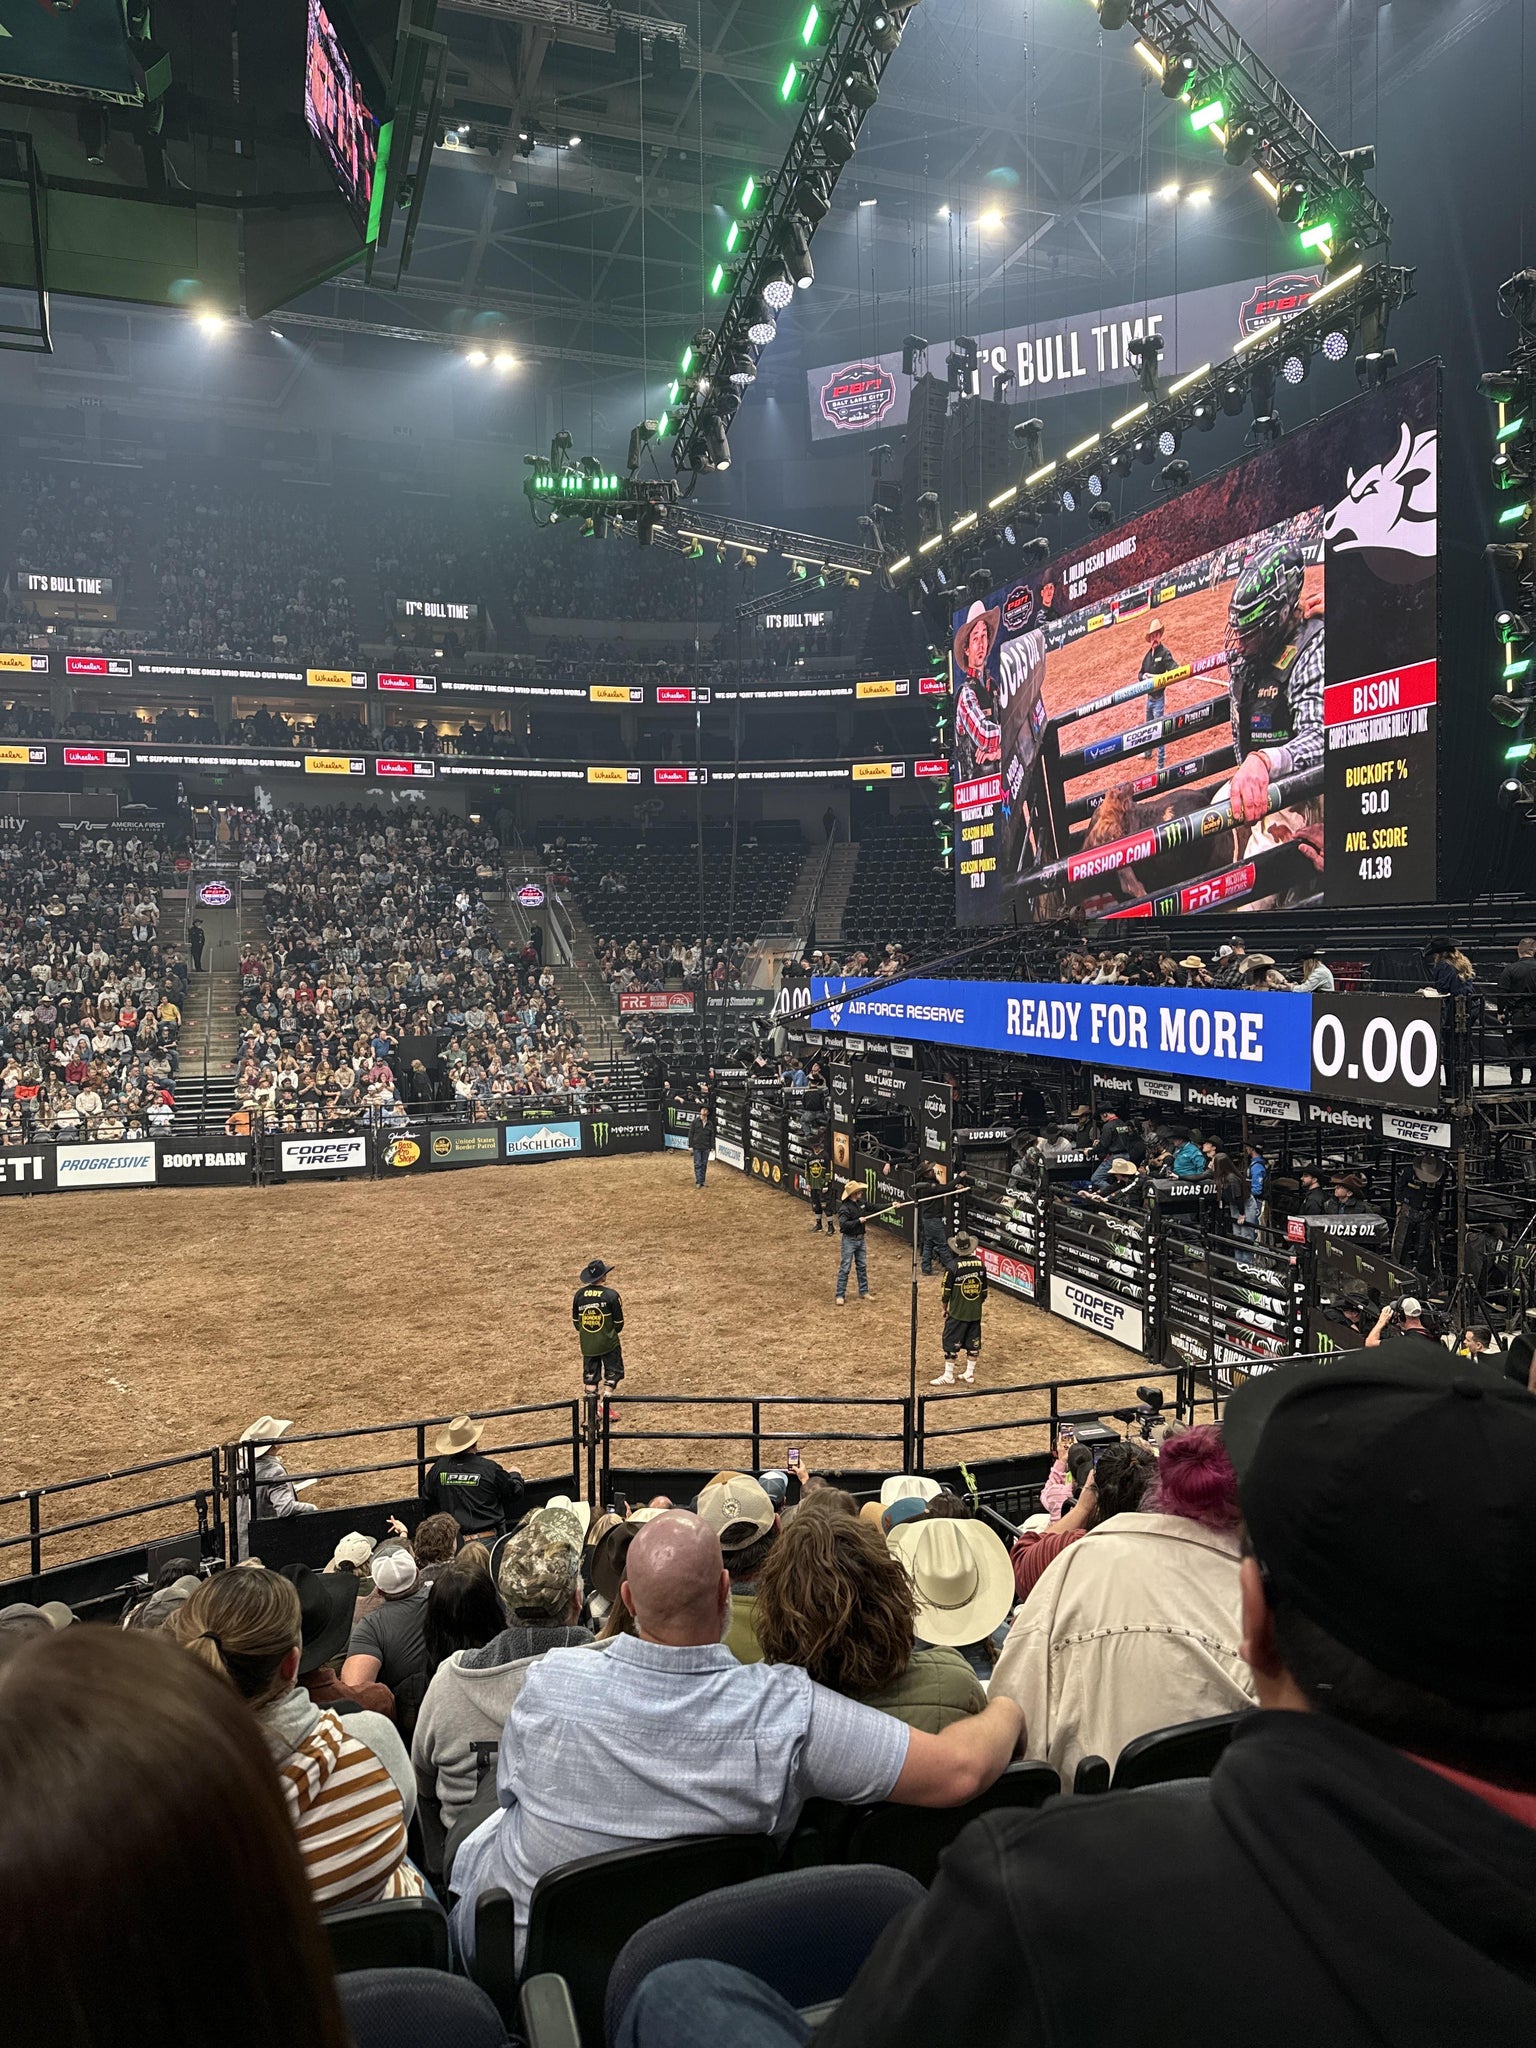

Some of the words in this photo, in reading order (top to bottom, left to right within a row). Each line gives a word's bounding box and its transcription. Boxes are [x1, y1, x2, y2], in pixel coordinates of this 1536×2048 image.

[1017, 331, 1086, 387] BULL
[832, 399, 848, 407] SALT
[850, 396, 867, 405] LAKE
[868, 393, 884, 401] CITY
[1069, 561, 1084, 583] JULIO
[1085, 551, 1105, 575] CESAR
[1106, 535, 1136, 565] MARQUES
[28, 575, 48, 591] IT'S
[50, 576, 75, 592] BULL
[76, 578, 102, 594] TIME
[1069, 577, 1088, 600] 86.05
[424, 602, 446, 618] BULL
[447, 604, 469, 619] TIME
[766, 614, 782, 628] IT'S
[783, 613, 803, 628] BULL
[31, 660, 46, 669] CAT
[71, 661, 102, 671] Wheeler
[1192, 657, 1215, 674] LUCAS
[152, 666, 185, 675] SUPPORT
[186, 668, 201, 676] THE
[202, 669, 221, 677] ONES
[222, 670, 239, 678] WHO
[240, 670, 261, 679] BUILD
[262, 671, 277, 679] OUR
[277, 672, 303, 681] WORLD
[314, 674, 346, 683] Wheeler
[352, 676, 364, 685] CAT
[383, 679, 410, 687] Wheeler
[864, 685, 890, 694] Wheeler
[597, 689, 624, 698] Wheeler
[630, 691, 641, 699] CAT
[661, 691, 686, 699] Wheeler
[1257, 685, 1278, 699] #nfp
[1353, 677, 1400, 714] BISON
[1127, 725, 1158, 742] COOPER
[1131, 734, 1153, 747] TIRES
[1329, 725, 1347, 750] COOPER
[30, 751, 44, 760] CAT
[69, 752, 100, 761] Wheeler
[313, 761, 344, 769] Wheeler
[381, 764, 408, 772] Wheeler
[860, 768, 886, 776] Wheeler
[919, 764, 944, 772] Wheeler
[595, 771, 622, 780] Wheeler
[1346, 761, 1394, 788] BUCKOFF
[1397, 758, 1408, 780] %
[956, 784, 977, 805] CALLUM
[979, 779, 1000, 800] MILLER
[1361, 789, 1389, 815] 50.0
[961, 807, 983, 822] WARWICK,
[962, 827, 979, 841] SEASON
[980, 823, 994, 839] RANK
[1346, 832, 1370, 852] AVG.
[1373, 826, 1408, 850] SCORE
[971, 839, 983, 855] 11TH
[961, 860, 979, 875] SEASON
[979, 857, 996, 873] POINTS
[1073, 842, 1150, 881] PBRSHOP.COM
[1359, 856, 1392, 880] 41.38
[1225, 871, 1248, 886] NICOTINE
[1189, 880, 1222, 910] FRE
[1224, 881, 1248, 897] POUCHES
[622, 996, 647, 1008] FRE
[730, 996, 755, 1006] Simulator
[849, 1001, 866, 1015] AIR
[867, 1003, 904, 1018] FORCE
[906, 1006, 964, 1024] RESERVE
[1007, 998, 1082, 1042] READY
[1091, 1002, 1148, 1050] FOR
[1159, 1007, 1264, 1062] MORE
[824, 1037, 844, 1047] Priefert
[867, 1042, 888, 1053] Priefert
[1312, 1013, 1438, 1088] 0.00
[864, 1074, 878, 1084] SALT
[878, 1077, 893, 1088] LAKE
[893, 1080, 907, 1090] CITY
[1093, 1074, 1133, 1092] Priefert
[1143, 1081, 1173, 1091] COOPER
[1149, 1088, 1169, 1097] TIRES
[1188, 1088, 1239, 1110] Priefert
[924, 1100, 939, 1112] LUCAS
[939, 1103, 947, 1114] OIL
[1253, 1097, 1290, 1109] COOPER
[1257, 1105, 1285, 1116] TIRES
[1309, 1104, 1374, 1131] Priefert
[610, 1125, 650, 1134] MONSTER
[1390, 1118, 1438, 1134] COOPER
[969, 1131, 994, 1140] LUCAS
[995, 1130, 1007, 1138] OIL
[1396, 1128, 1430, 1141] TIRES
[287, 1142, 361, 1156] COOPER
[398, 1141, 412, 1149] Bass
[455, 1143, 475, 1151] Border
[60, 1156, 150, 1172] PROGRESSIVE
[163, 1153, 204, 1168] BOOT
[205, 1152, 246, 1167] BARN
[297, 1153, 349, 1165] TIRES
[398, 1154, 416, 1163] Shops
[1057, 1153, 1084, 1163] LUCAS
[877, 1180, 905, 1200] MONSTER
[1170, 1185, 1201, 1196] LUCAS
[1202, 1183, 1218, 1194] OIL
[1359, 1224, 1376, 1236] OIL
[1069, 1247, 1079, 1255] SALT
[1079, 1251, 1090, 1260] LAKE
[1090, 1255, 1100, 1263] CITY
[957, 1260, 982, 1269] AUSTIN
[1065, 1285, 1125, 1320] COOPER
[1186, 1292, 1200, 1301] SALT
[1215, 1303, 1228, 1311] CITY
[1073, 1303, 1115, 1330] TIRES
[1170, 1334, 1189, 1351] WORLD
[1189, 1343, 1208, 1361] FINALS
